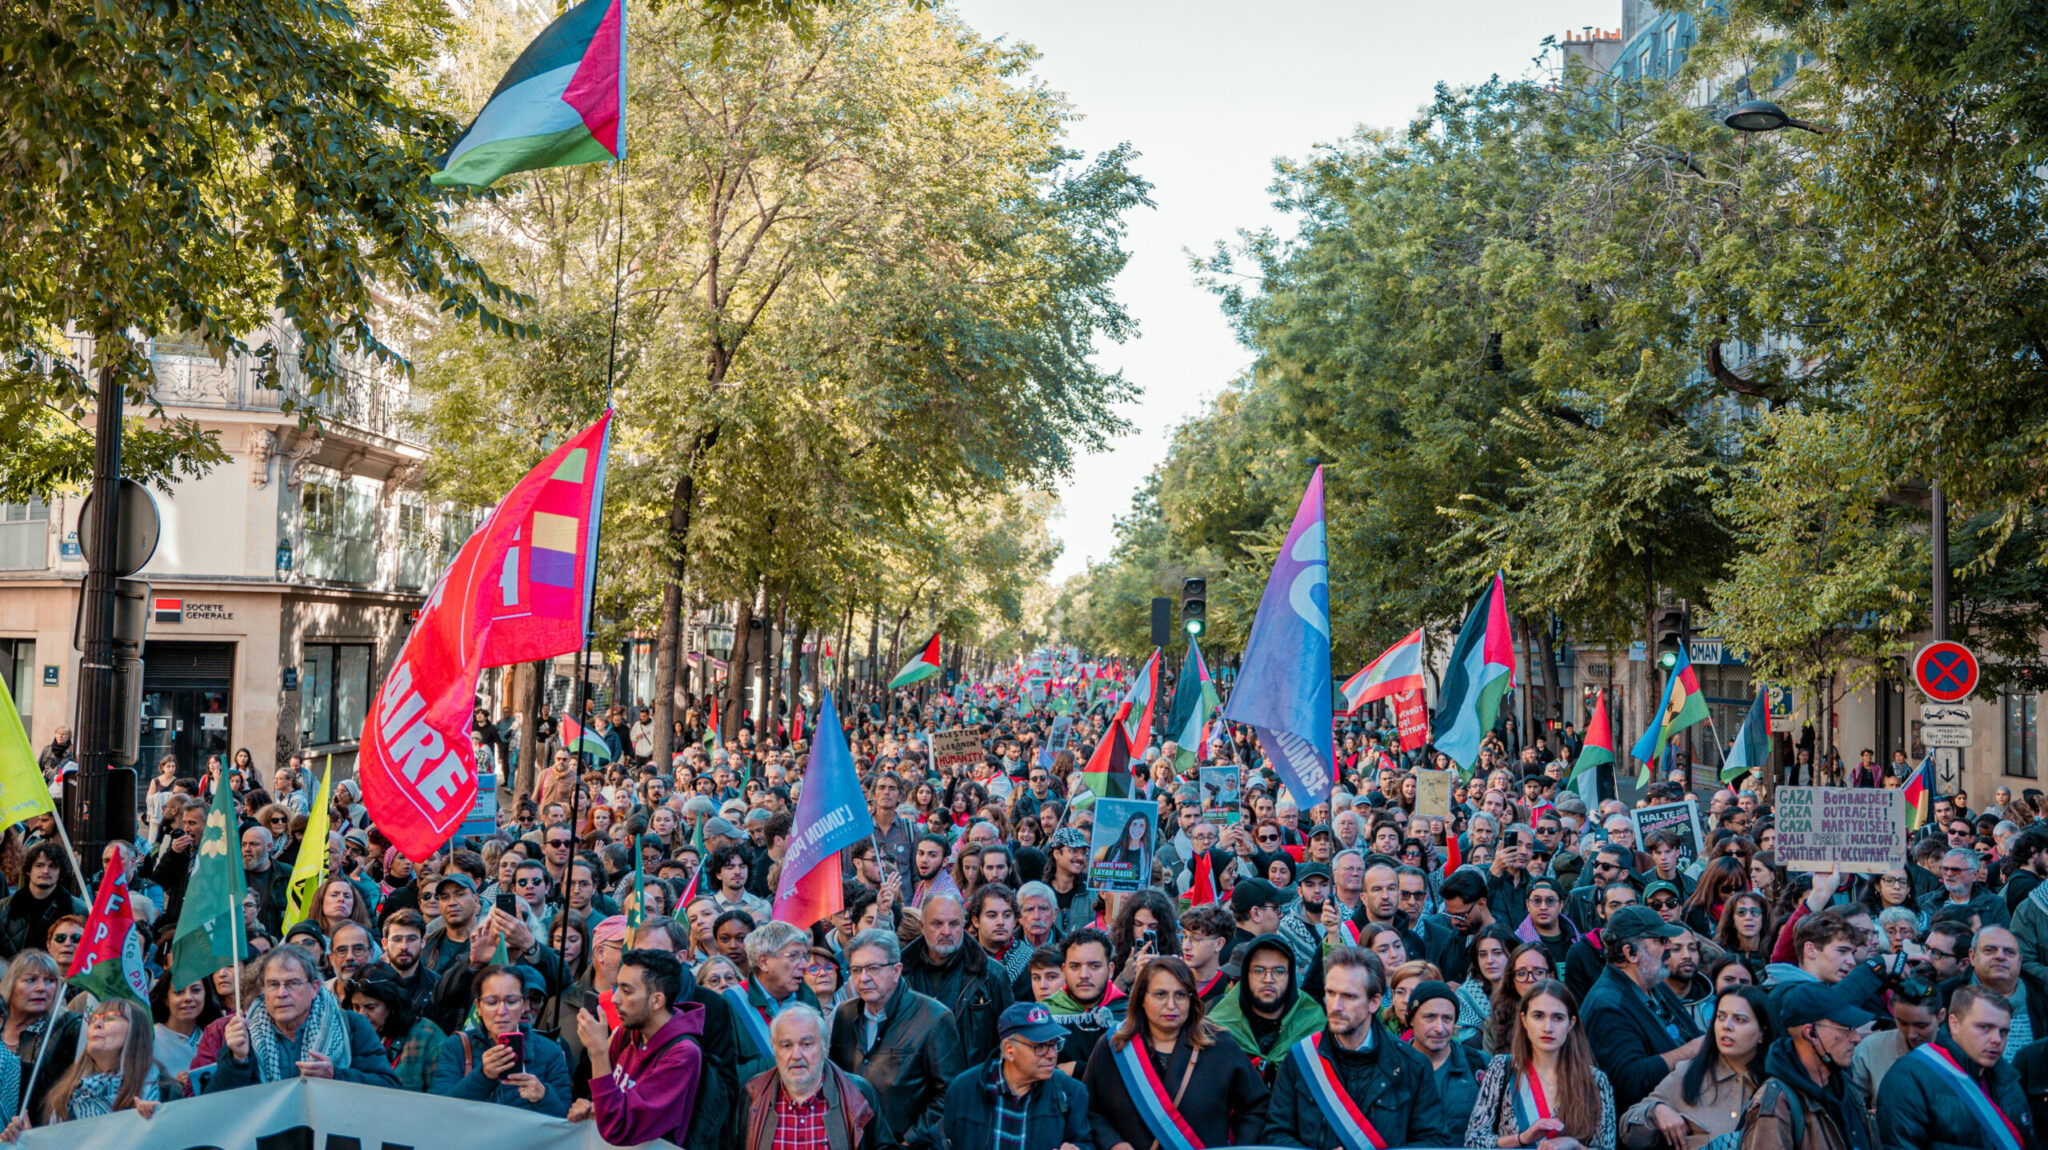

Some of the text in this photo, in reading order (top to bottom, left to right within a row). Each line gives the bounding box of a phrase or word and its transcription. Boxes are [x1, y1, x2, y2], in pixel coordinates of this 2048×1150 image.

[186, 604, 224, 612] SOCIETE
[186, 612, 234, 620] GENERALE
[934, 729, 979, 739] PALESTINE
[941, 741, 976, 750] LEBANON
[938, 752, 983, 767] HUMANITY
[1779, 789, 1813, 805] GAZA
[1779, 806, 1812, 818] GAZA
[1779, 820, 1813, 832] GAZA
[1778, 833, 1805, 845] MAIS
[1777, 846, 1827, 861] SOUTIENT
